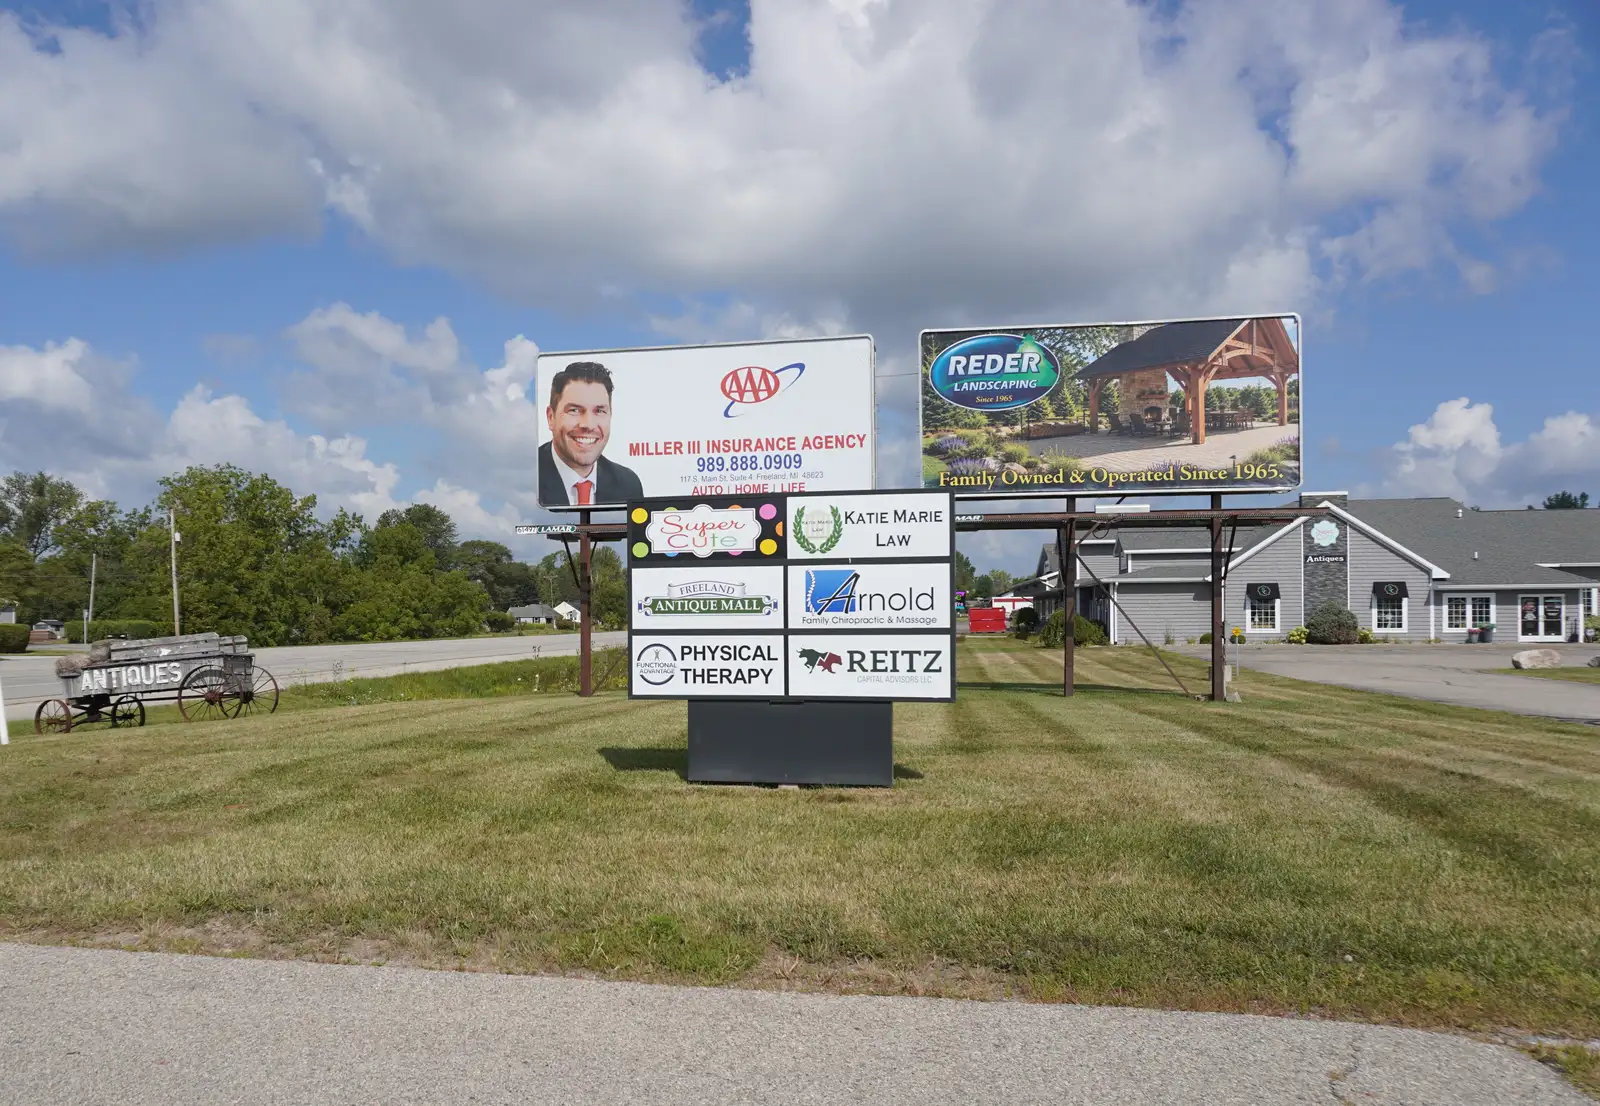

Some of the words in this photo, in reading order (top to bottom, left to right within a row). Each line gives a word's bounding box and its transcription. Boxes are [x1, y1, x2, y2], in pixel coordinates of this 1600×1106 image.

[948, 352, 1041, 376] REDER
[728, 367, 774, 402] AAA
[954, 380, 1038, 392] LANDSCAPING
[629, 441, 684, 456] MILLER
[688, 440, 701, 454] III
[706, 436, 797, 454] INSURANCE
[801, 433, 867, 450] AGENCY
[697, 453, 803, 472] 989.888.0909
[680, 475, 691, 483] 117
[701, 474, 718, 482] Main
[730, 472, 747, 481] Suite
[789, 471, 799, 479] MI
[802, 470, 824, 479] 48623
[938, 470, 997, 490] Family
[1001, 468, 1064, 485] Owned
[1069, 469, 1086, 483] &
[1090, 465, 1175, 487] Operated
[1180, 465, 1228, 481] Since
[1233, 463, 1284, 480] 1965.
[692, 484, 724, 496] AUTO
[735, 483, 769, 494] HOME
[780, 482, 806, 493] LIFE
[844, 511, 889, 524] KATIE
[893, 509, 943, 523] MARIE
[541, 525, 572, 533] LAMAR
[660, 514, 746, 537] Super
[667, 533, 737, 548] Cute
[876, 533, 911, 547] LAW
[1306, 555, 1344, 563] Antiques
[680, 583, 735, 596] FREELAND
[817, 572, 934, 615] Arnold
[655, 599, 718, 613] ANTIQUE
[720, 600, 761, 611] MALL
[802, 617, 829, 625] Family
[831, 616, 885, 625] Chiropractic
[887, 616, 894, 624] &
[896, 616, 938, 626] Massage
[680, 645, 779, 661] PHYSICAL
[846, 650, 942, 673] REITZ
[81, 661, 183, 692] ANTIQUES
[680, 668, 774, 684] THERAPY
[856, 675, 882, 683] CAPITAL
[885, 675, 919, 683] ADVISORS
